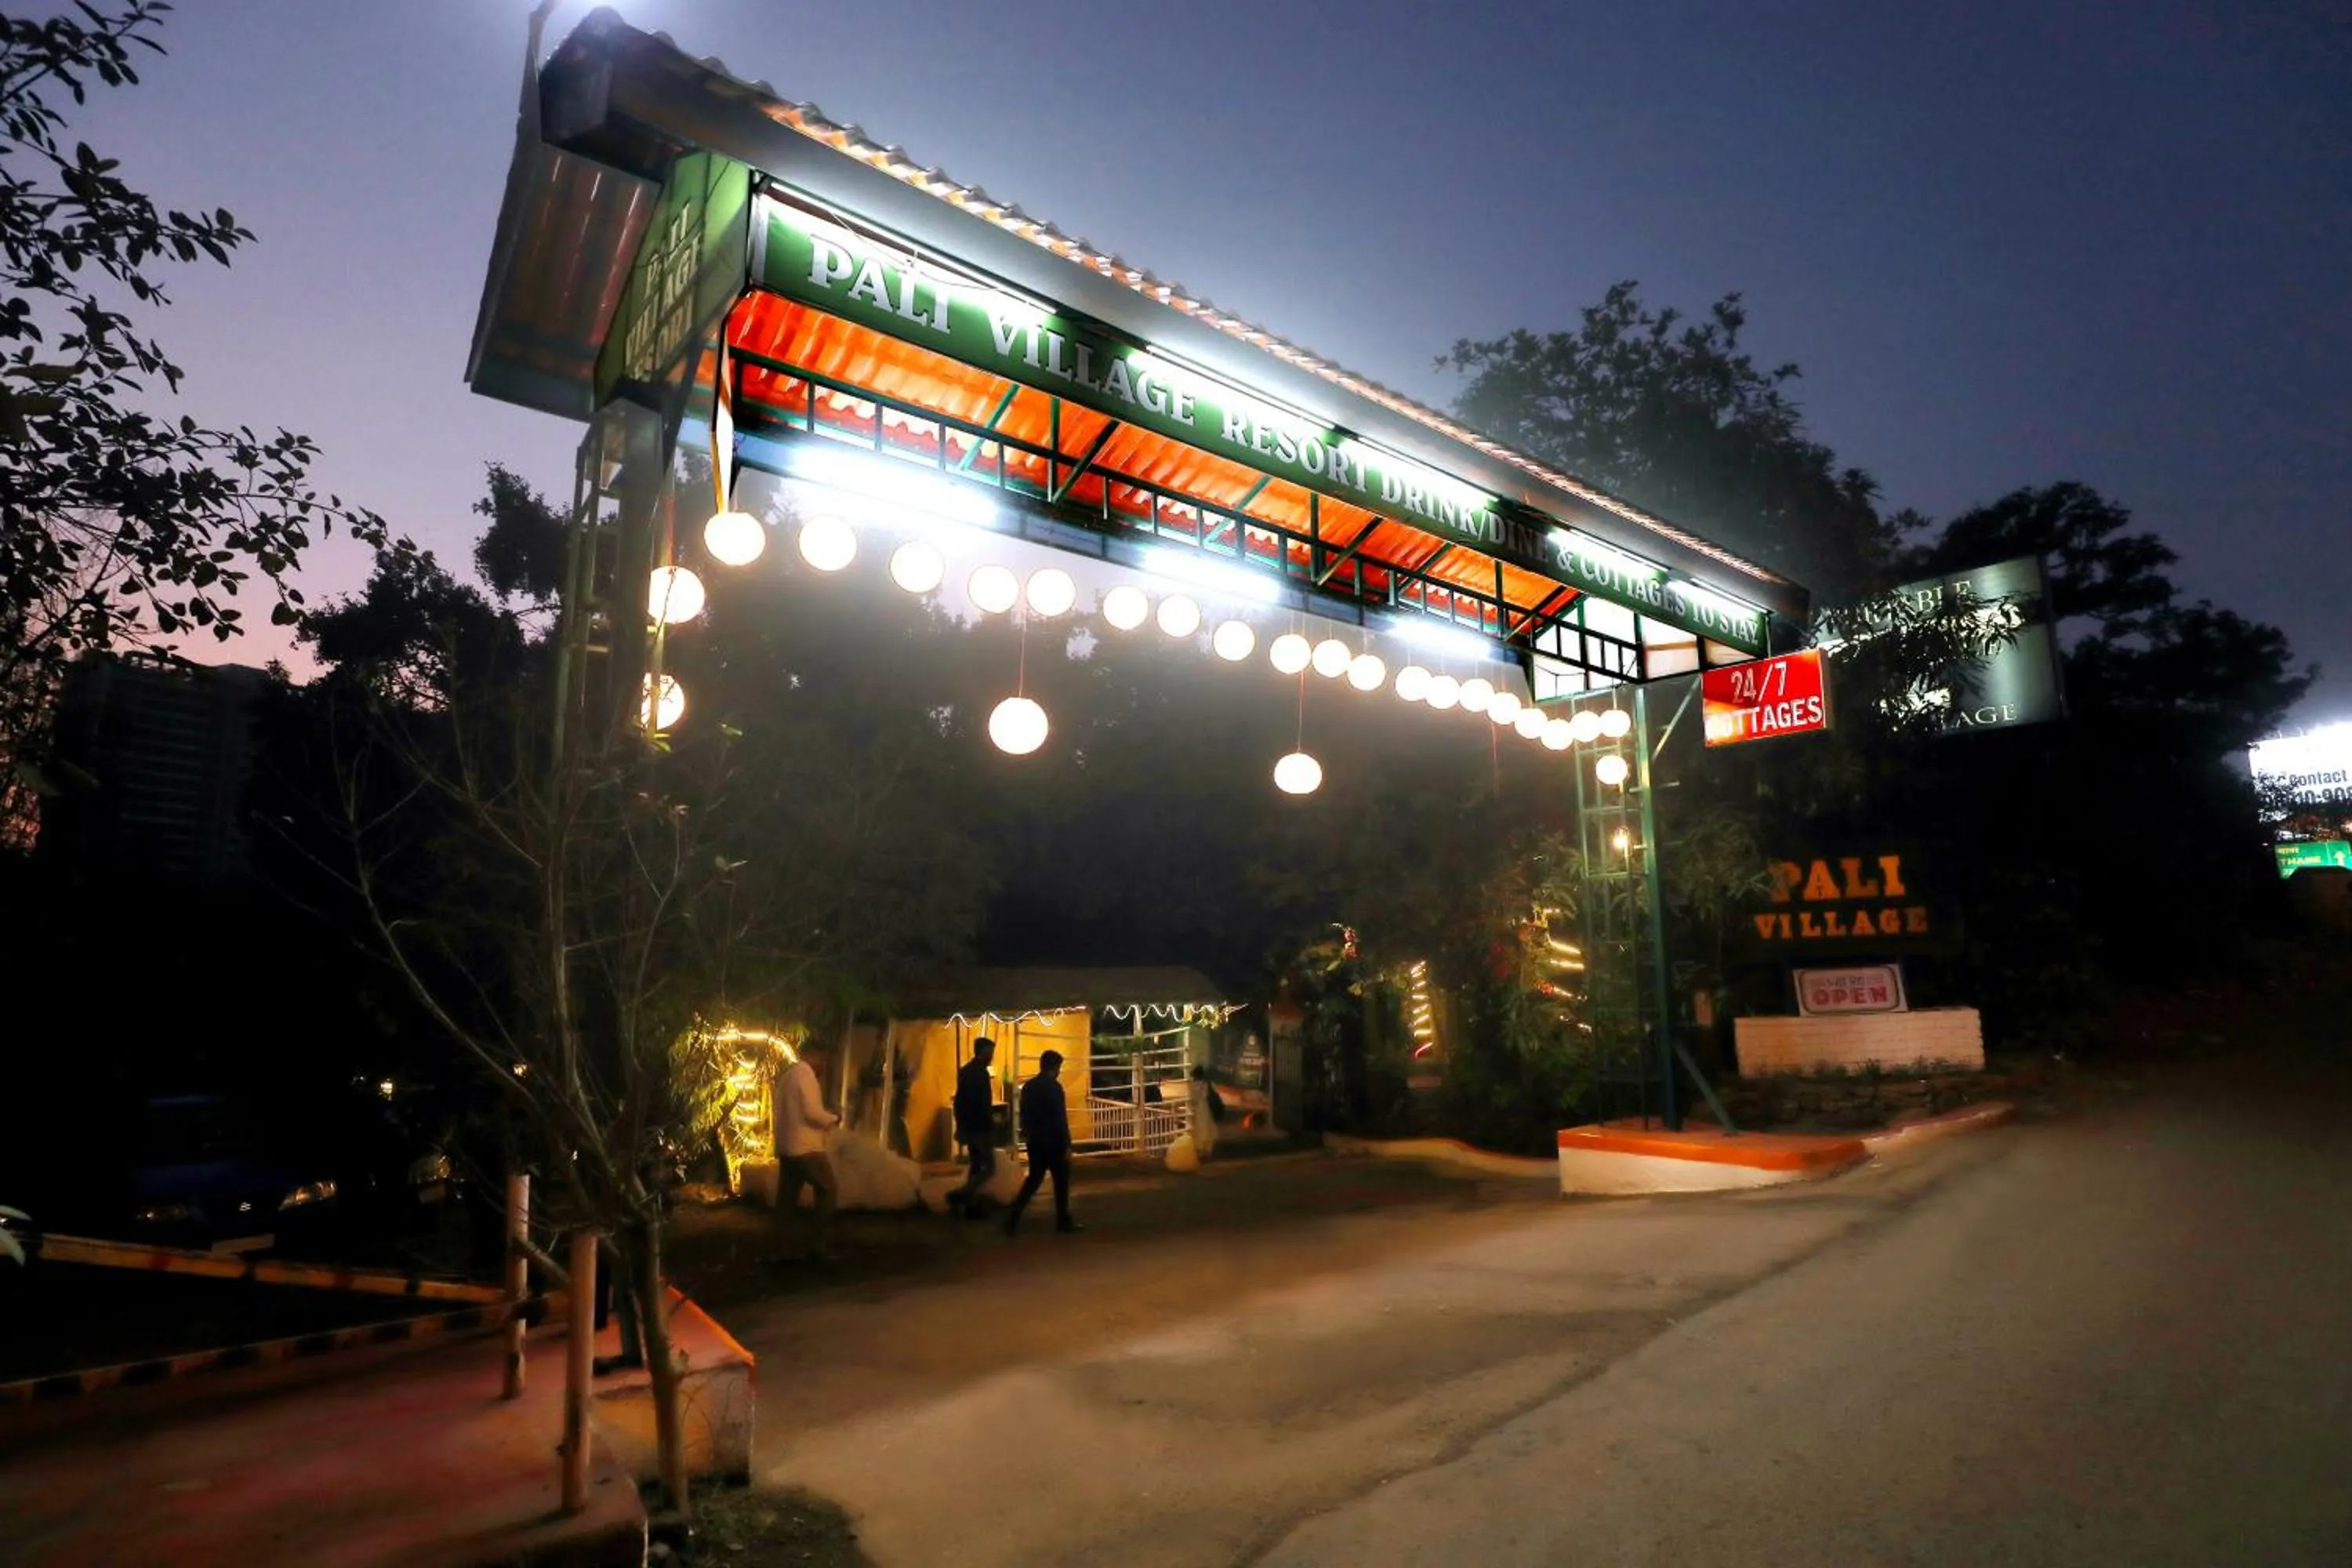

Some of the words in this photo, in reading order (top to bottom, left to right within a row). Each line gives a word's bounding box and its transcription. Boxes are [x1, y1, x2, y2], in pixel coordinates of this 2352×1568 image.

[808, 234, 951, 334] PALI
[988, 311, 1196, 426] VILLAGE
[1221, 400, 1369, 493] RESORT
[1556, 546, 1575, 575] &
[1719, 612, 1759, 645] STAY
[1730, 661, 1788, 703] 24/7
[1706, 695, 1823, 739] TTAGES
[1766, 855, 1907, 904] PALI
[1754, 906, 1929, 939] VILLAGE
[1813, 985, 1888, 1006] OPEN
